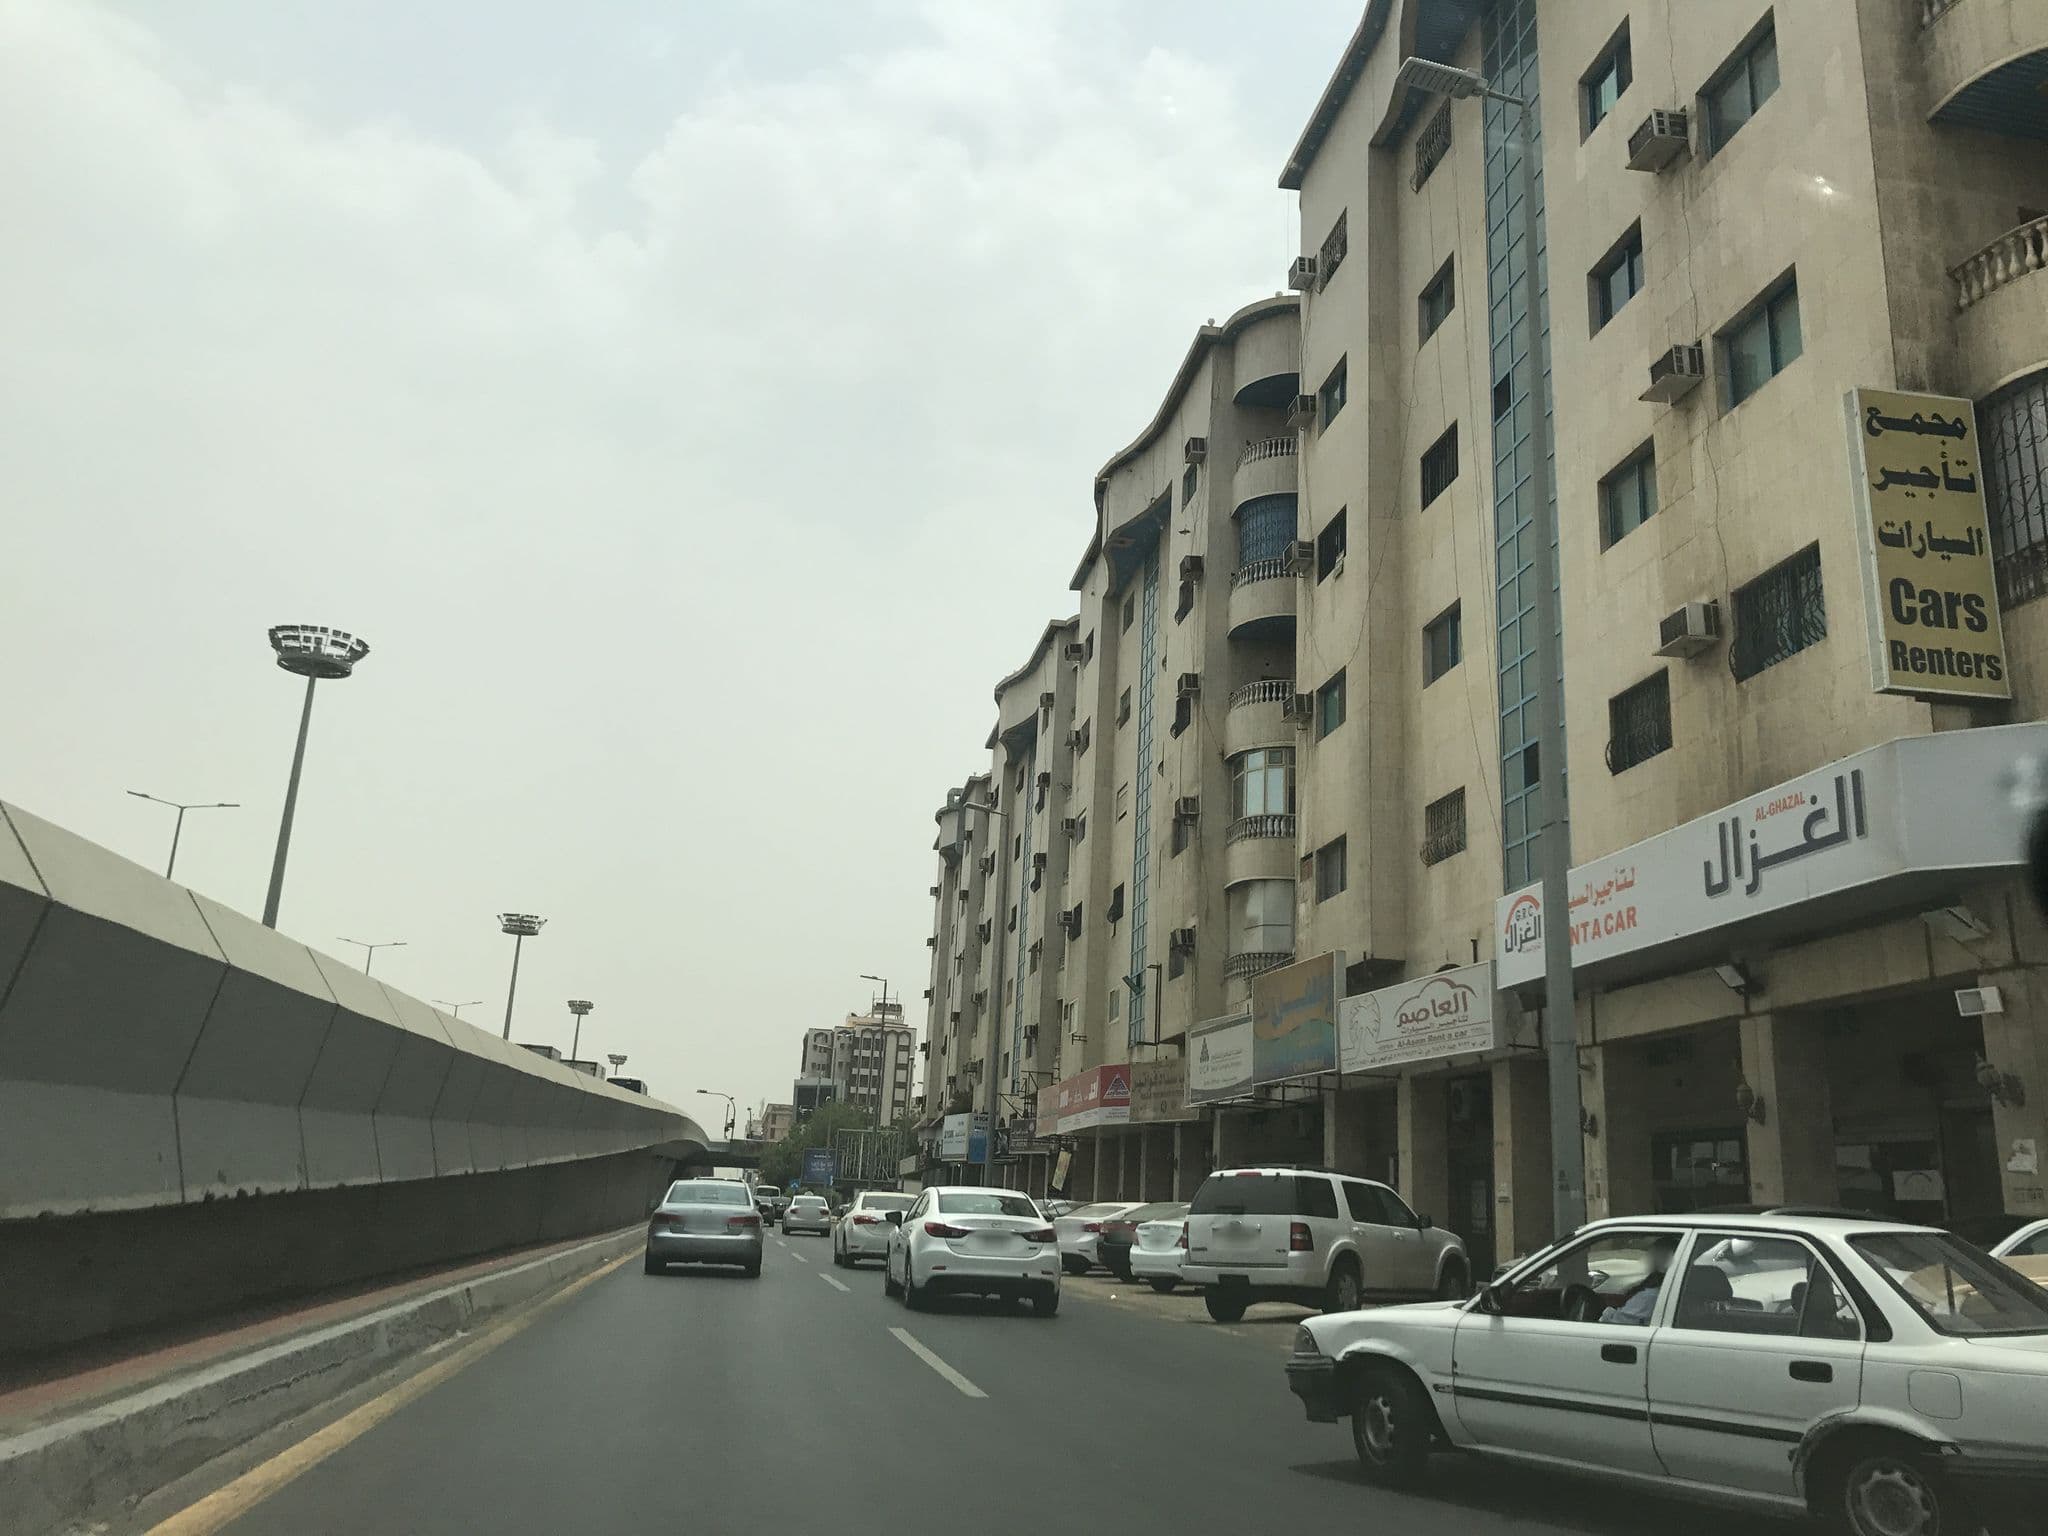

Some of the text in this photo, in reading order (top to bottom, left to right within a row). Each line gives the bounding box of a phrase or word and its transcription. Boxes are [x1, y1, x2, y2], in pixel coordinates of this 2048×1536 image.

[1866, 406, 1968, 446] مجمع
[1872, 450, 1977, 499] تأجير
[1877, 520, 1984, 562] السيارات
[1889, 577, 1988, 633] Cars
[1890, 639, 2003, 681] Renters
[1755, 791, 1806, 821] AL-GHAZAL
[1703, 768, 1868, 897] الغزال
[1504, 914, 1542, 953] الغزال
[1604, 905, 1638, 936] CAR
